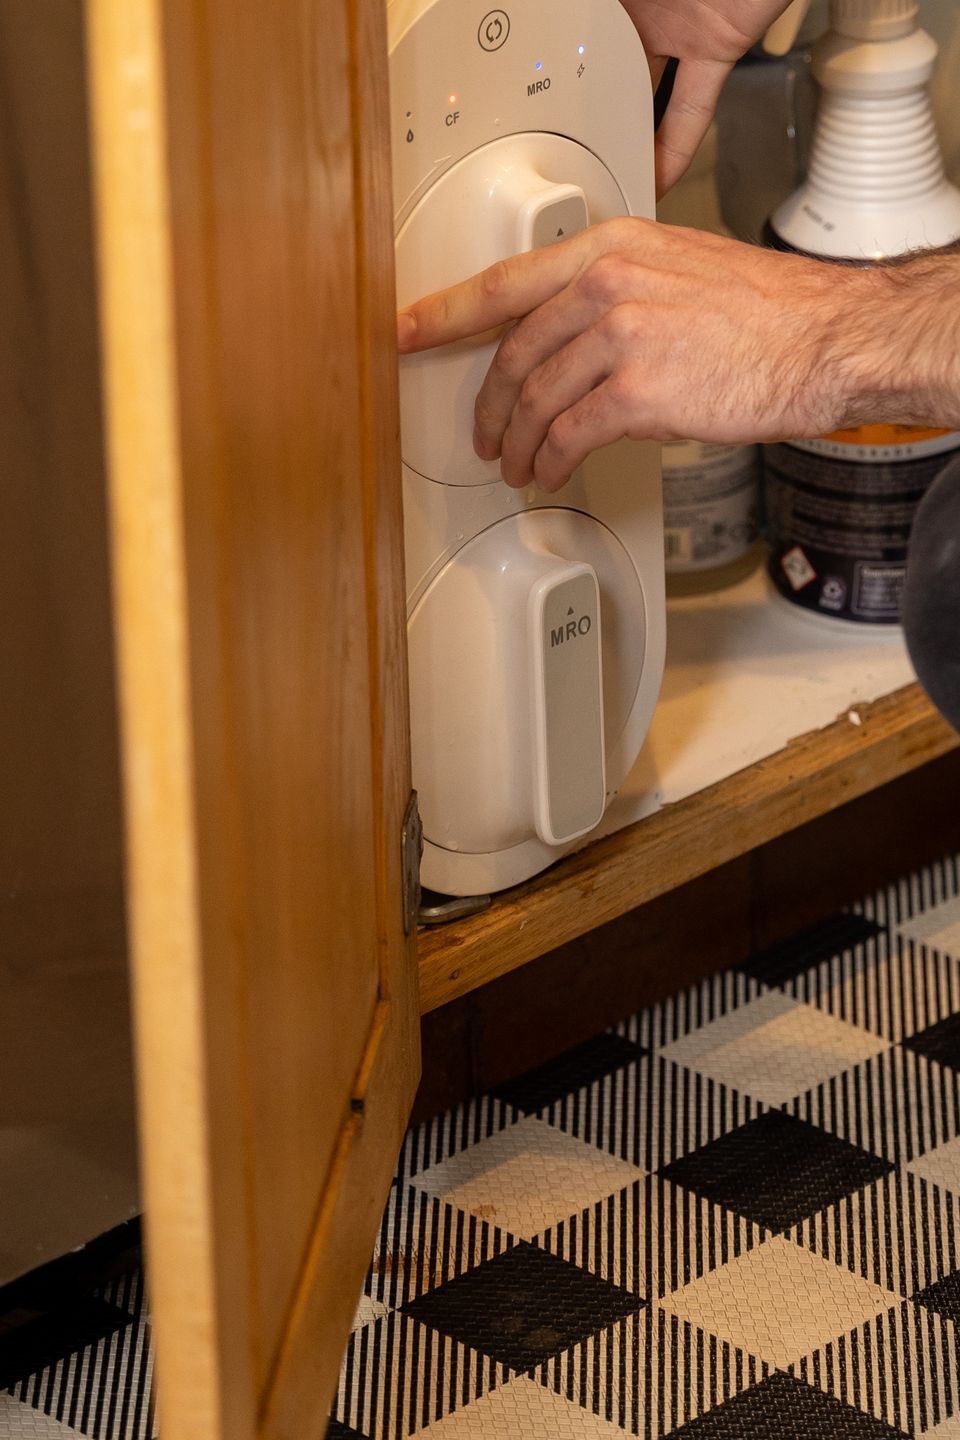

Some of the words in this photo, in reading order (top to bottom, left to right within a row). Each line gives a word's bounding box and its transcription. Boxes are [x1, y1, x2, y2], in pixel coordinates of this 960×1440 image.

[527, 77, 551, 97] MRO
[445, 111, 460, 127] CF
[550, 615, 592, 648] MRO
